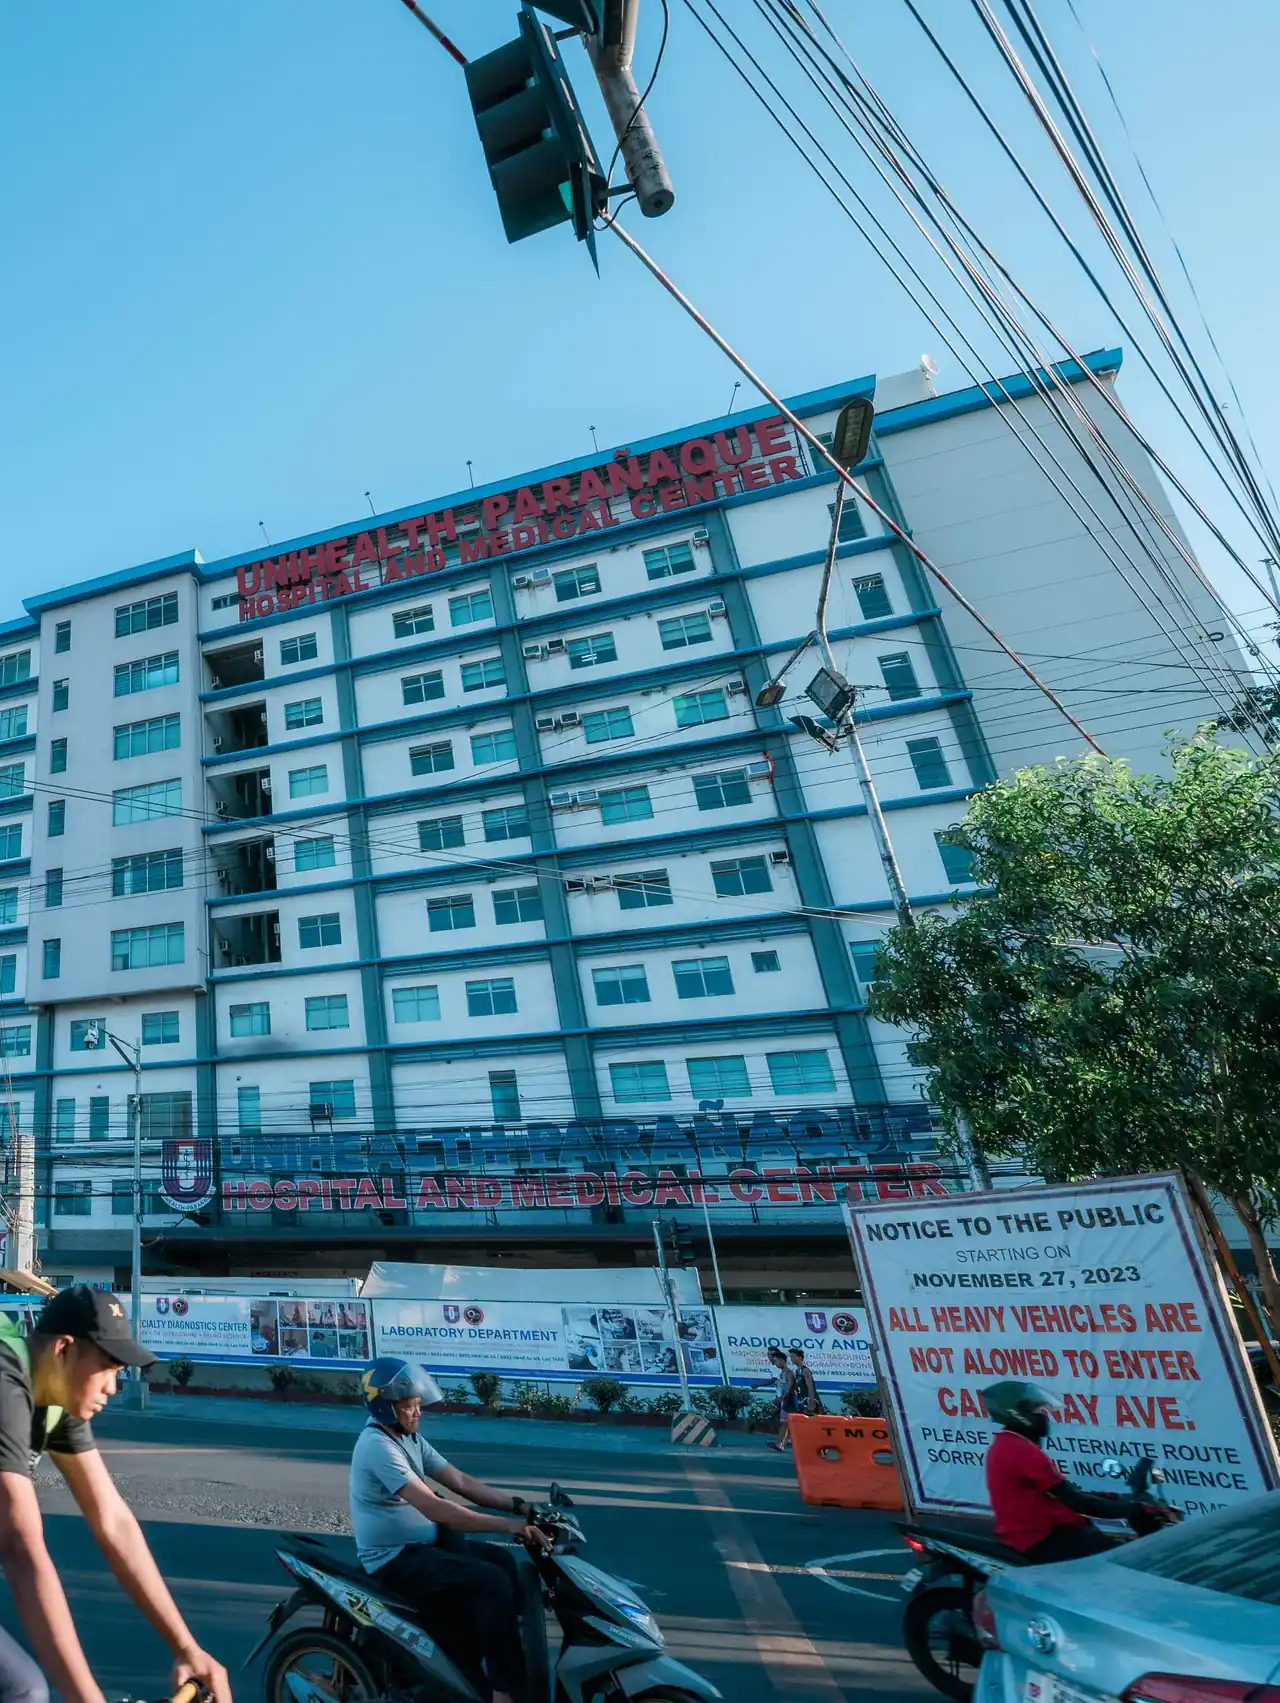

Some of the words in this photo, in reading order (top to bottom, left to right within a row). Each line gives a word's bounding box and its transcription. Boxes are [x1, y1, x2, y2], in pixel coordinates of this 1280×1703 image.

[238, 570, 370, 622] HOSPITAL
[384, 549, 447, 584] AND
[460, 504, 619, 564] MEDICAL
[630, 455, 804, 520] CENTER
[222, 1178, 407, 1211] HOSPITAL
[416, 1176, 502, 1208] AND
[509, 1169, 721, 1207] MEDICAL
[728, 1161, 950, 1203] CENTER
[866, 1217, 954, 1242] NOTICE
[958, 1215, 992, 1238] TO
[998, 1210, 1053, 1235] THE
[1058, 1202, 1165, 1231] PUBLIC
[956, 1245, 1040, 1264] STARTING
[1043, 1244, 1071, 1260] ON
[913, 1271, 1035, 1289] NOVEMBER
[1039, 1270, 1077, 1289] 27,
[1081, 1265, 1141, 1285] 2023
[167, 1320, 217, 1331] DIAGNOSTICS
[218, 1321, 248, 1332] CENTER
[888, 1305, 929, 1333] ALL
[935, 1304, 1006, 1333] HEAVY
[1009, 1302, 1137, 1333] VEHICLES
[1145, 1302, 1203, 1333] ARE
[381, 1325, 465, 1338] LABORATORY
[468, 1328, 559, 1342] DEPARTMENT
[727, 1336, 825, 1350] RADIOLOGY
[831, 1339, 869, 1351] AND
[908, 1346, 954, 1375] NOT
[963, 1347, 1059, 1378] ALOWED
[1063, 1349, 1099, 1379] TO
[1107, 1349, 1201, 1381] ENTER
[1115, 1394, 1196, 1431] AVE.
[922, 1426, 990, 1446] PLEASE
[1045, 1436, 1157, 1460] ALTERNATE
[1160, 1443, 1242, 1465] ROUTE
[927, 1447, 985, 1467] SORRY
